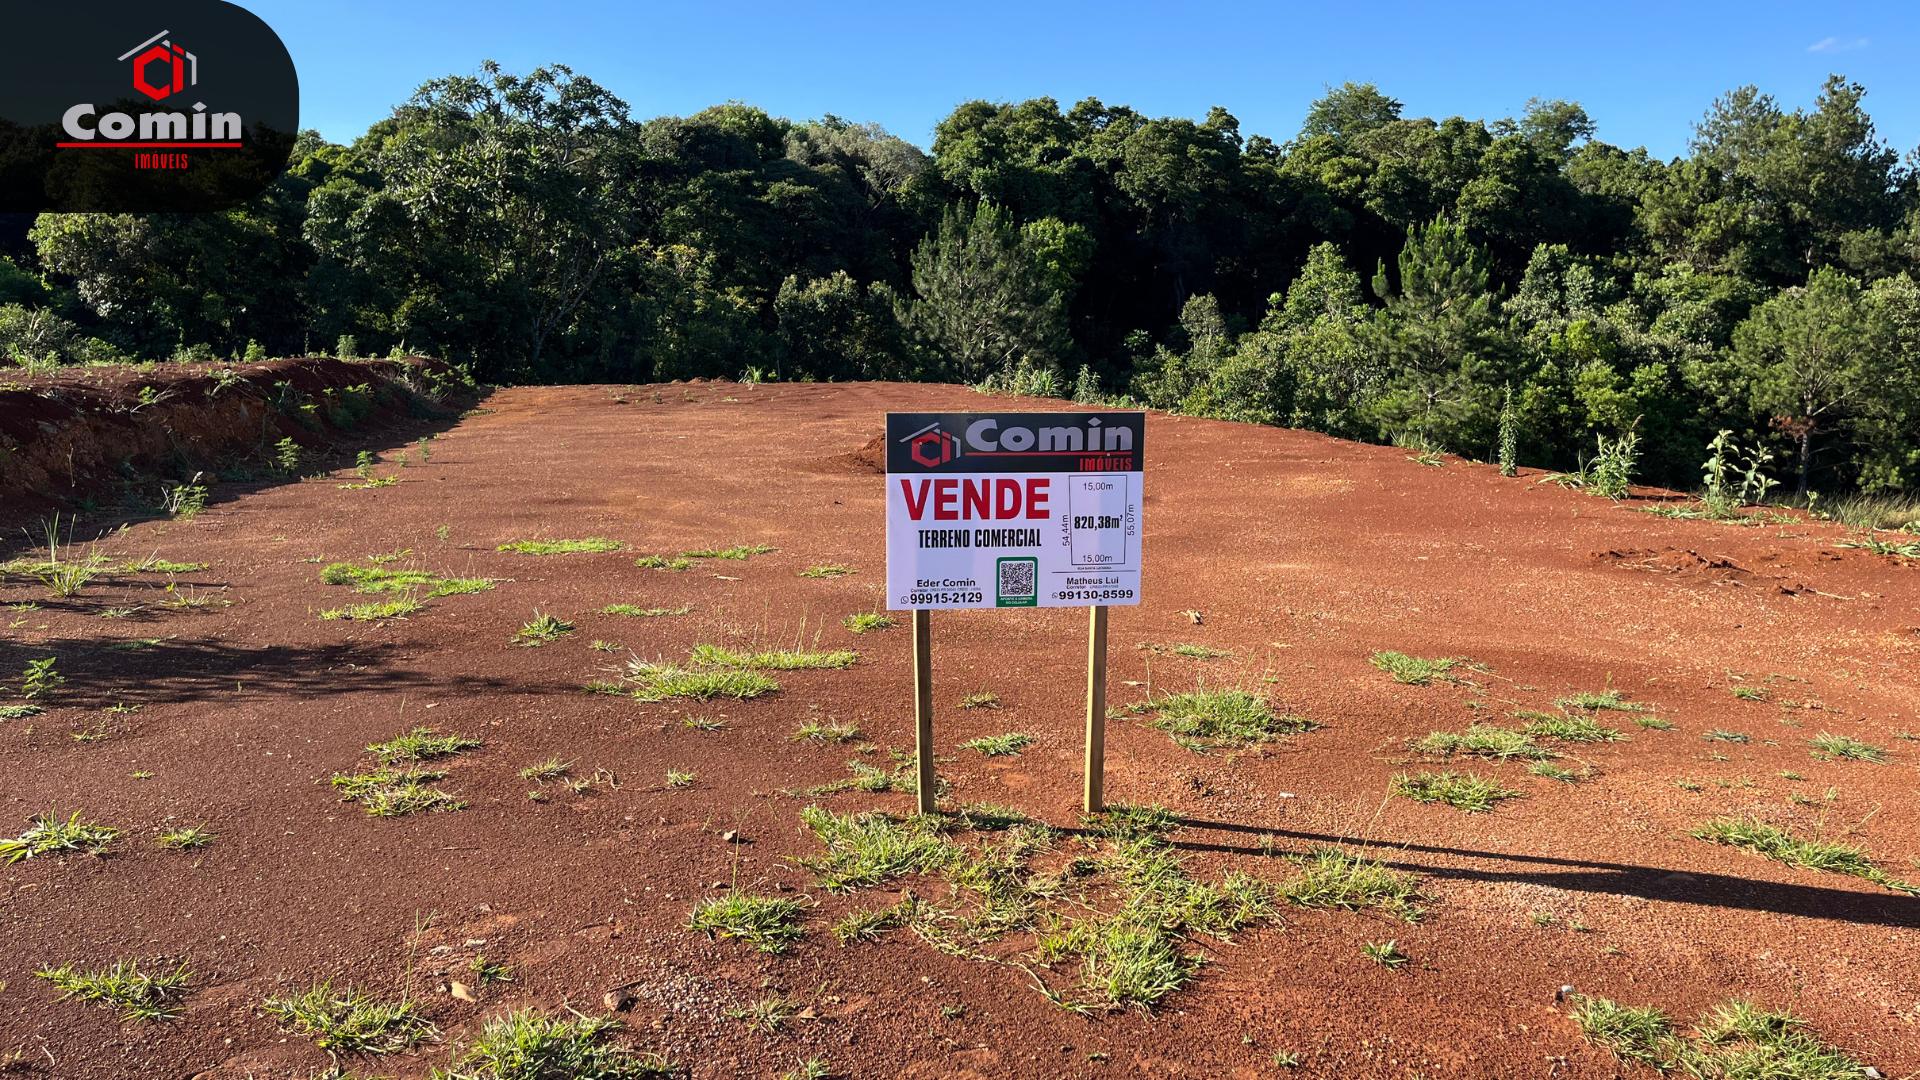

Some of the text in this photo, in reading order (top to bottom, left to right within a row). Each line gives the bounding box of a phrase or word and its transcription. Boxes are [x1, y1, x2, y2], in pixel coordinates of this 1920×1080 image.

[965, 416, 1133, 452] Comin
[1079, 456, 1133, 472] IMÓVEIS
[1083, 482, 1114, 491] 15,00m
[900, 478, 1050, 521] VENDE
[1074, 514, 1123, 531] 820,38m²
[1127, 504, 1135, 536] 55,07m
[918, 528, 1042, 548] TERRENO COMERCIAL
[1062, 514, 1071, 547] 54,44m
[1082, 554, 1113, 563] 15,00m
[916, 578, 976, 588] Eder Comin
[1066, 576, 1119, 585] Matheus Lui
[910, 592, 983, 604] 99915-2129
[1058, 589, 1134, 600] 99130-8599
